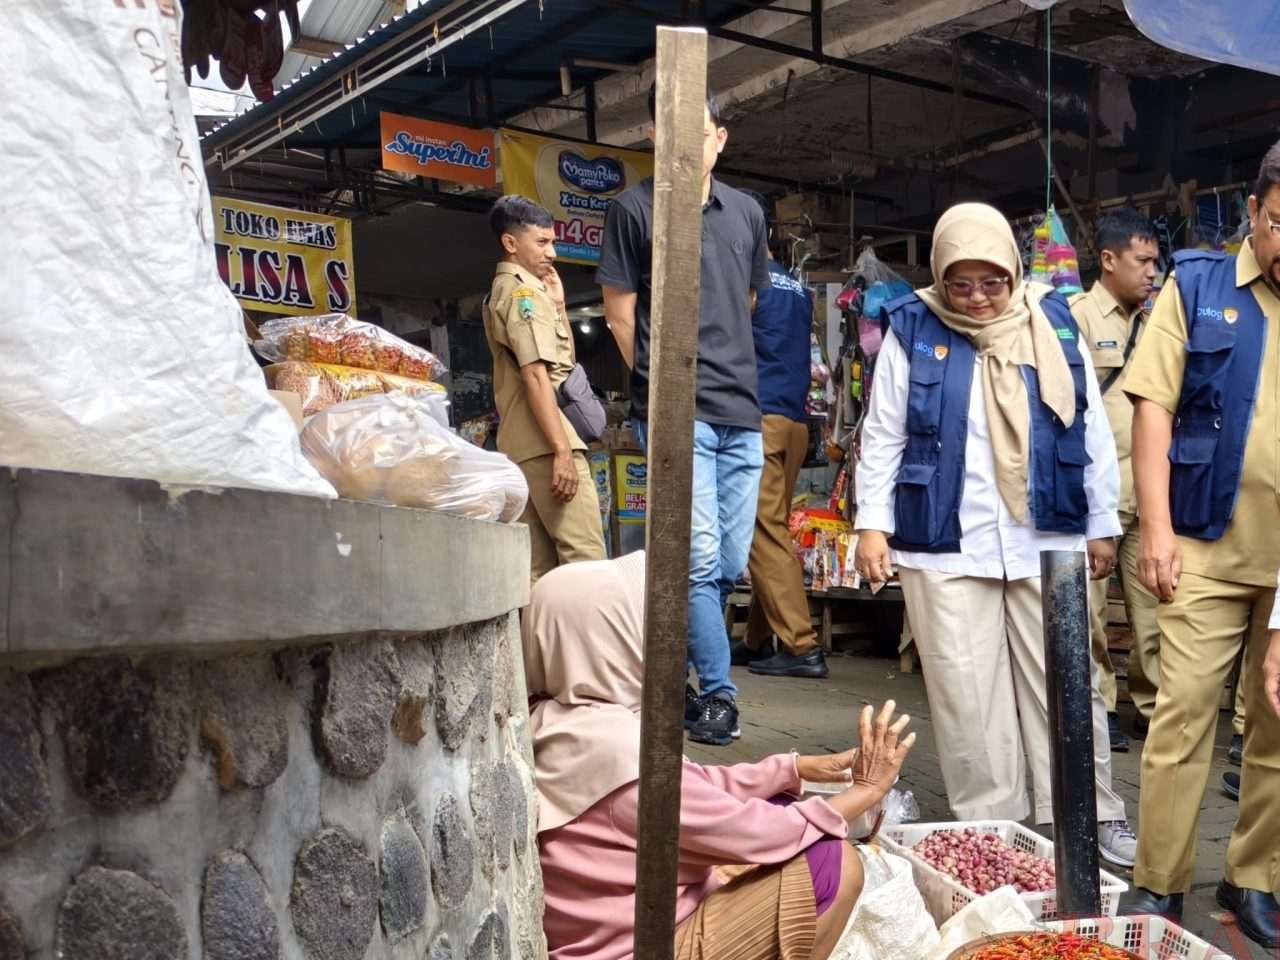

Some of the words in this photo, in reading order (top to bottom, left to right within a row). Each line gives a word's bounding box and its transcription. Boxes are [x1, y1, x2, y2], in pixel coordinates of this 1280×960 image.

[425, 135, 447, 146] instan
[580, 177, 605, 188] pants
[220, 207, 280, 241] TOKO
[285, 218, 337, 250] EMAS
[325, 259, 351, 314] S
